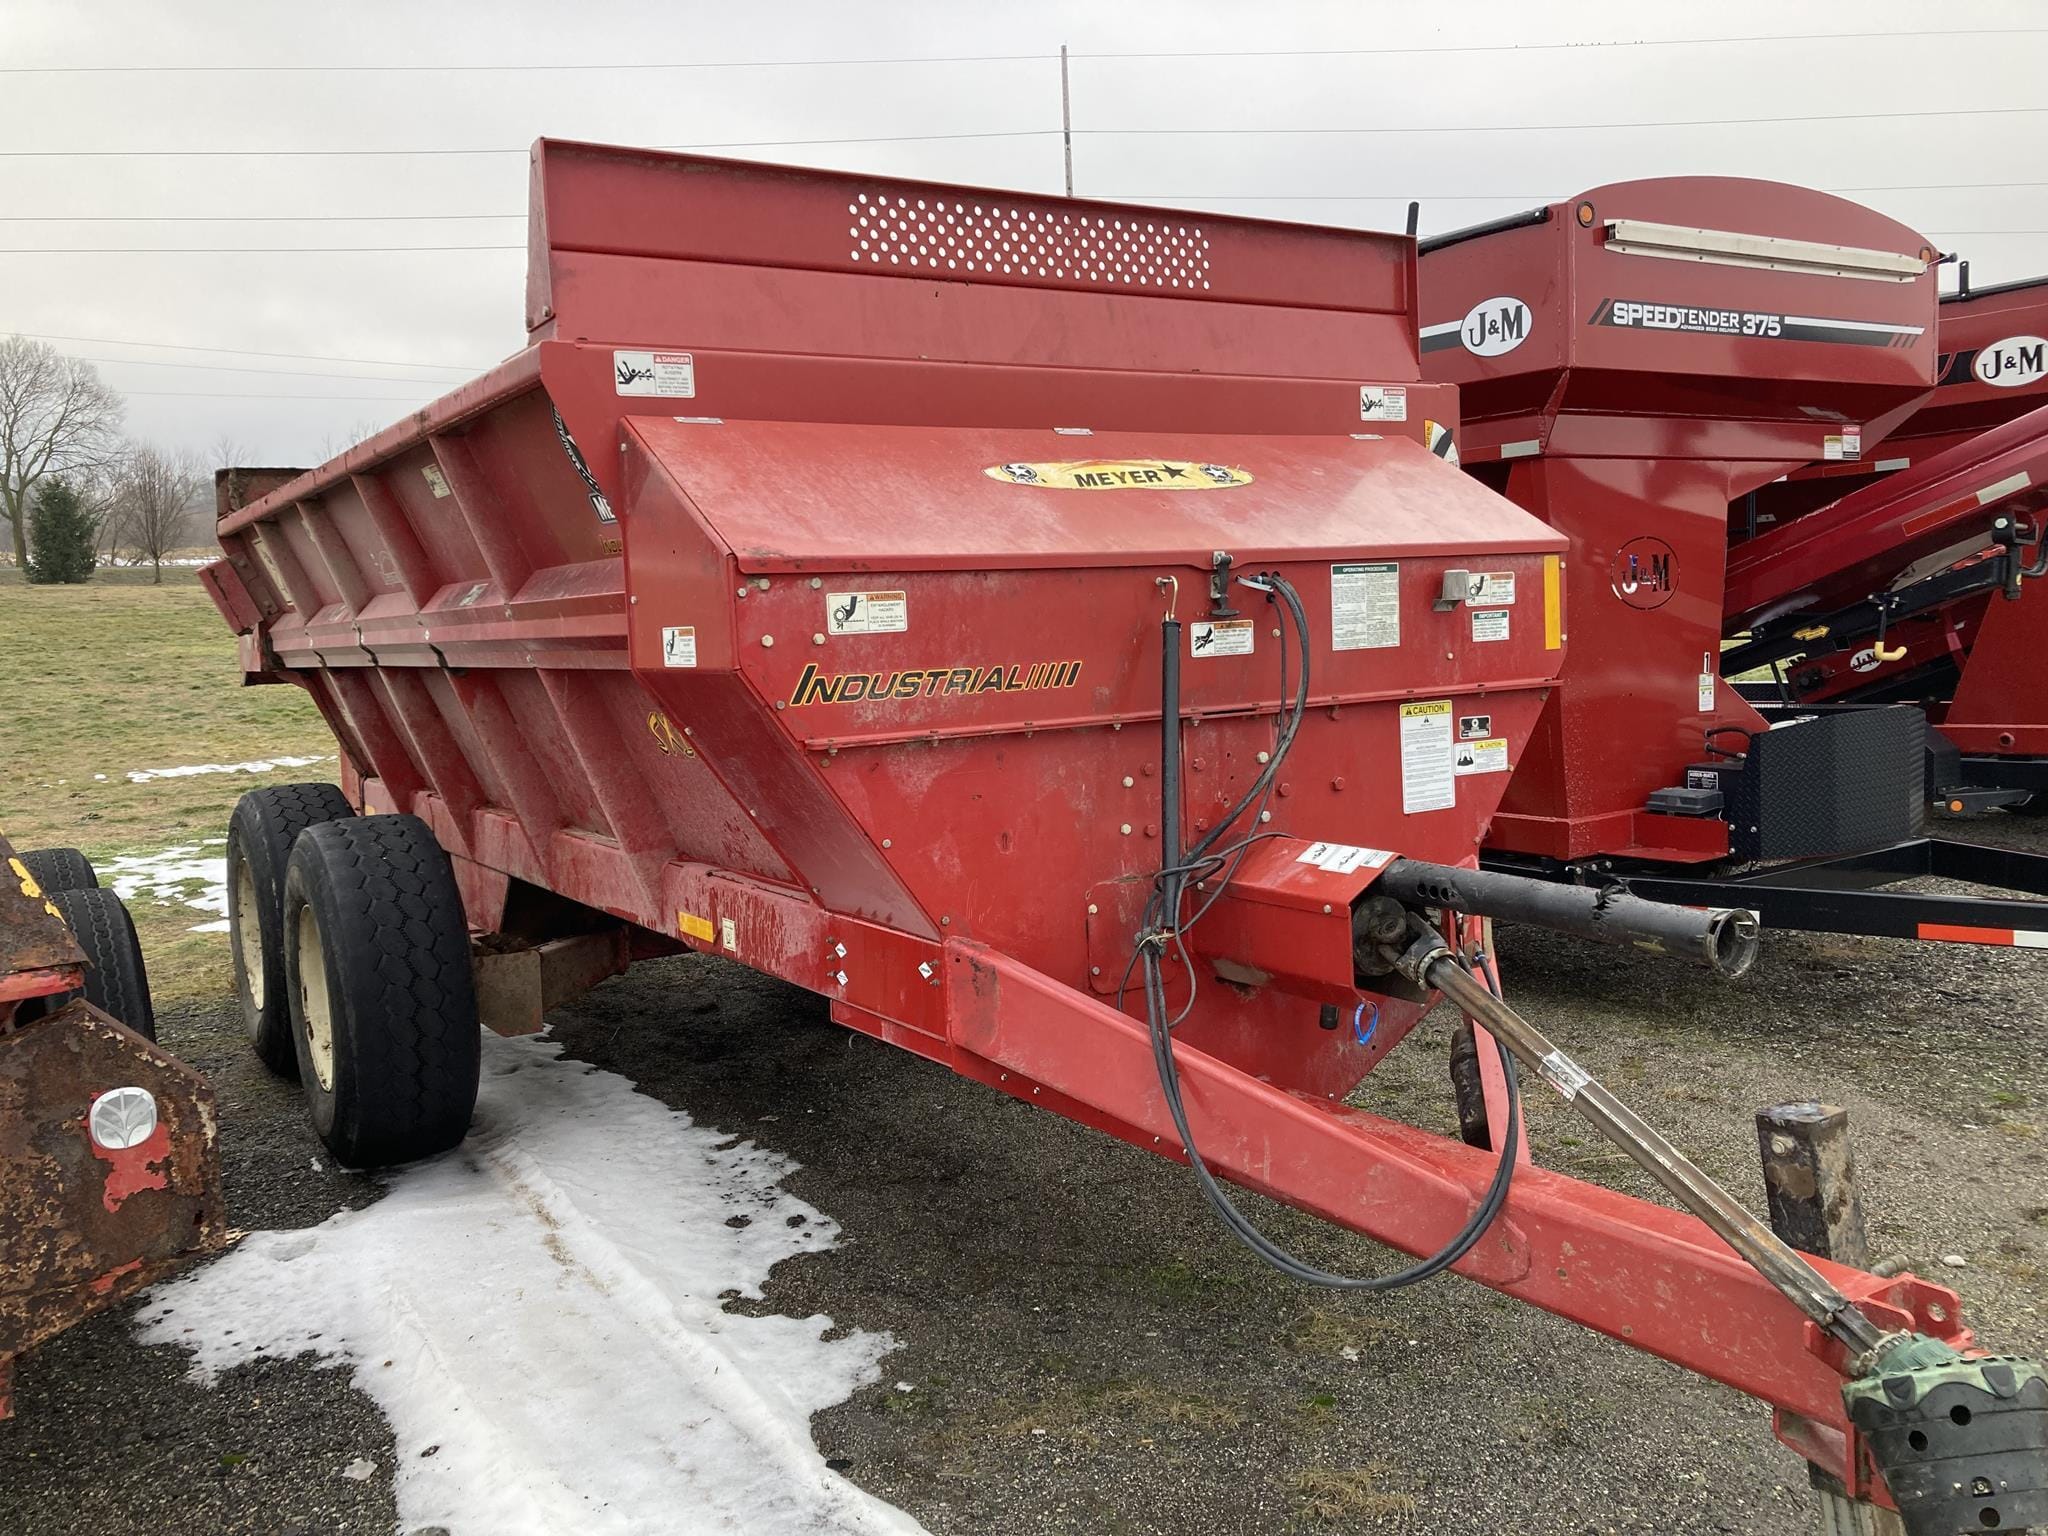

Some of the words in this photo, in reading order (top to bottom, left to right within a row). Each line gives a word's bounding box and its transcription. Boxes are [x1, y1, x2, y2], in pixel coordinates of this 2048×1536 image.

[1468, 304, 1524, 347] J&M
[1742, 313, 1782, 337] 375
[1981, 344, 2045, 379] J&M
[1073, 470, 1163, 488] MEYER
[789, 662, 1027, 707] INDUSTRIAL
[1412, 704, 1445, 715] CAUTION
